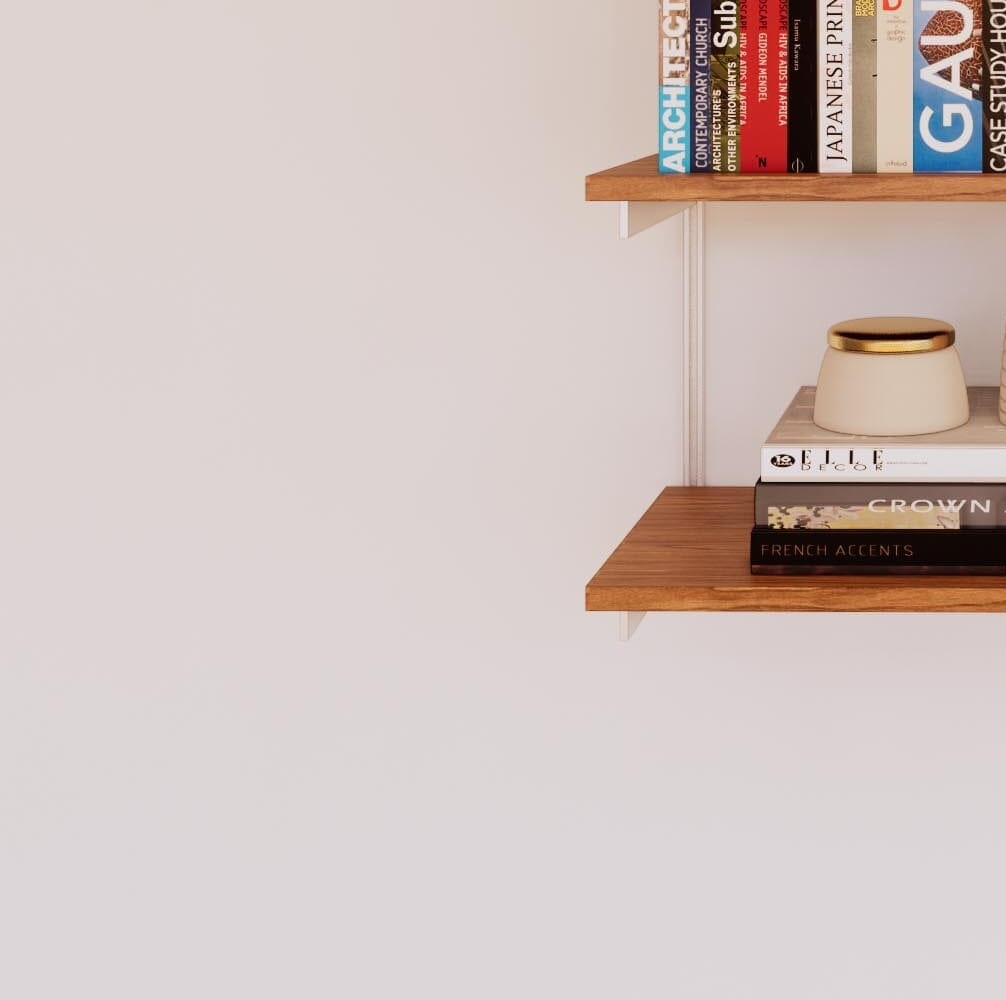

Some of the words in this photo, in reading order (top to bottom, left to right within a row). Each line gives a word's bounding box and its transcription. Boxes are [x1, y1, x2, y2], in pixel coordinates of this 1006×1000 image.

[695, 18, 707, 66] CHURCH
[758, 33, 767, 66] GIDEON
[779, 33, 787, 48] HIV
[758, 68, 767, 102] MENDEL
[779, 60, 787, 81] AIDS
[728, 61, 737, 136] ENVIRONMENTS
[779, 94, 787, 126] AFRICA
[827, 53, 847, 161] JAPANESE
[695, 70, 707, 168] CONTEMPORARY
[728, 138, 737, 172] OTHER
[802, 450, 883, 464] ELLE
[868, 499, 990, 513] CROWN
[761, 544, 827, 557] FRENCH
[835, 544, 914, 557] ACCENTS
